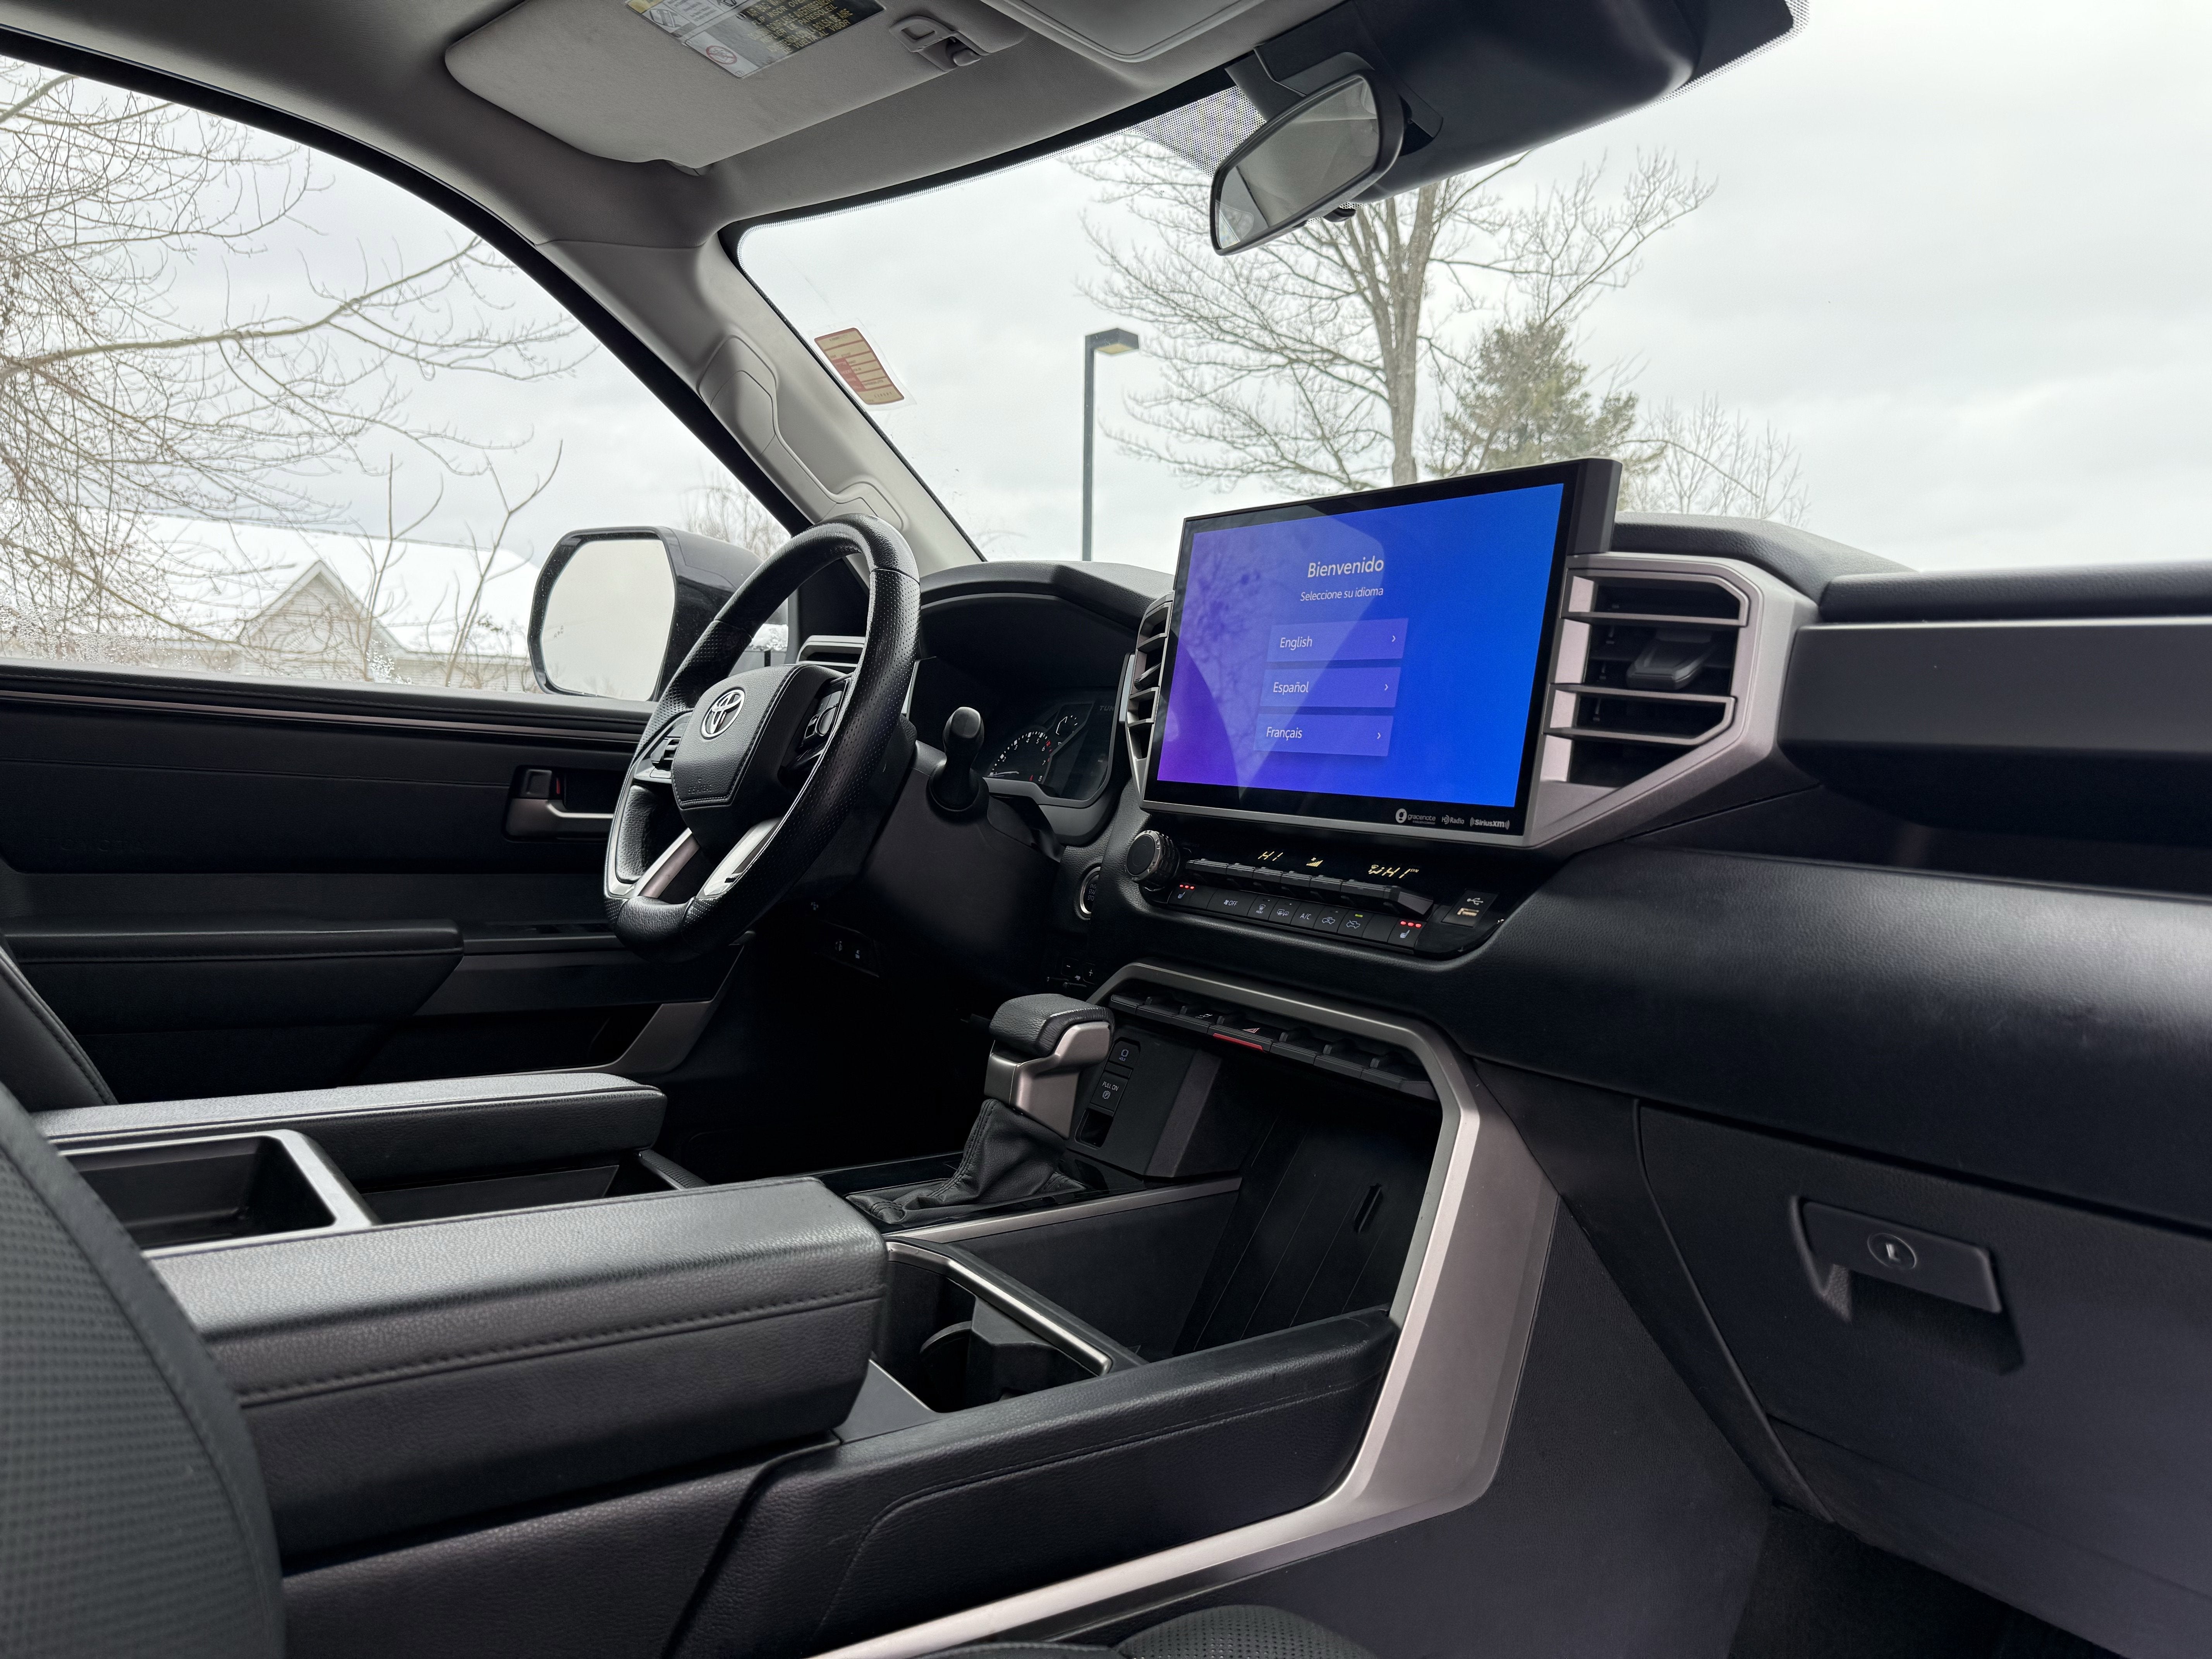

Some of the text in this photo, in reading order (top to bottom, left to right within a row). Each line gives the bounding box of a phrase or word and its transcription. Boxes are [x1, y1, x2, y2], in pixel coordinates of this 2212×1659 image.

[755, 2, 771, 12] BAG
[793, 0, 833, 18] AVERTISSEME
[798, 4, 838, 25] PARESOLEIL
[751, 16, 765, 26] FLIP
[767, 6, 788, 18] VISOR
[813, 19, 834, 31] BOLSA
[793, 34, 819, 49] VUELTA
[829, 19, 851, 31] VISOR
[1307, 555, 1384, 578] Bienvenido
[1300, 587, 1384, 601] Seleccione su idioma
[1279, 636, 1312, 651] English
[1273, 681, 1309, 695] Español
[1266, 726, 1303, 741] Français
[1450, 816, 1464, 824] Radio
